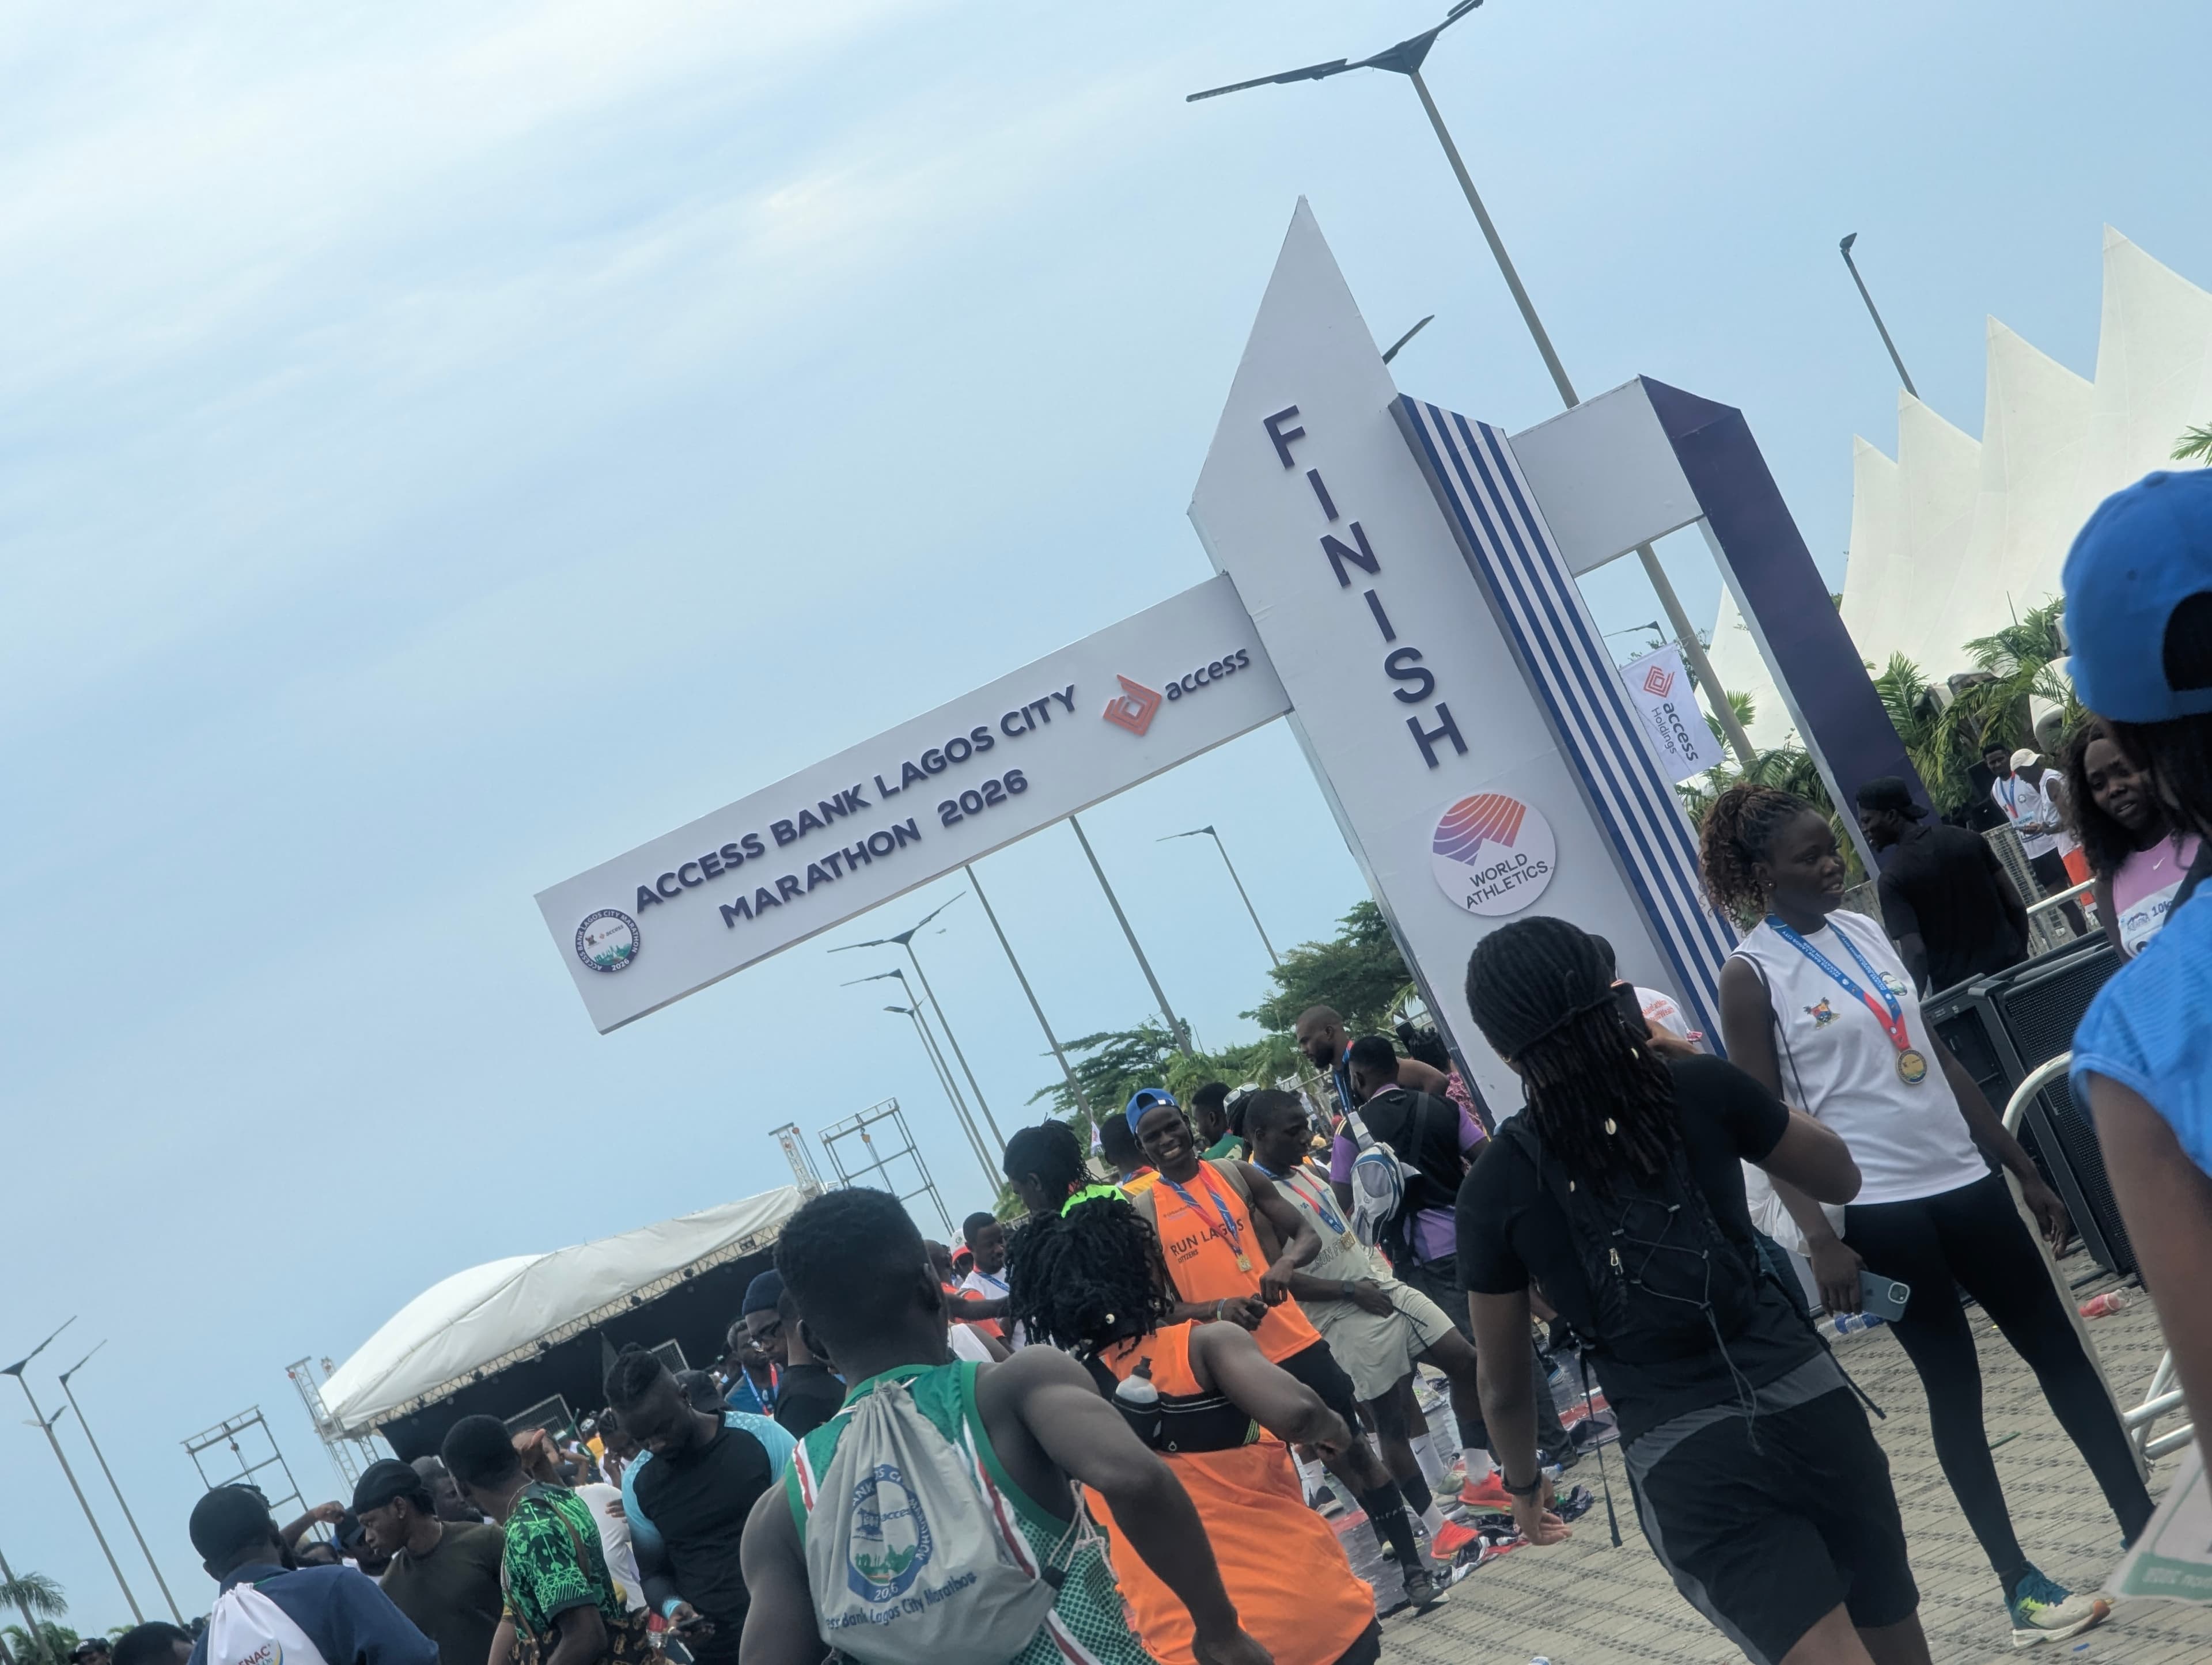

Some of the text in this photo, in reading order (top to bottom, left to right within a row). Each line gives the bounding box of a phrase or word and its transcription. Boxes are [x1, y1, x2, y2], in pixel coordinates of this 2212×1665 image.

[1263, 404, 1469, 770] FINISH
[1165, 648, 1250, 701] access
[1652, 707, 1677, 754] Holdings
[1662, 703, 1699, 762] access
[637, 684, 1076, 914] ACCESS BANK LAGOS CITY
[719, 769, 1028, 929] MARATHON 2026
[1469, 853, 1528, 887] WORLD
[1466, 860, 1548, 909] ATHLETICS
[581, 913, 602, 931] LAGOS
[620, 915, 639, 953] MARATHON
[611, 958, 630, 972] 2026
[1170, 1234, 1198, 1257] RUN
[1200, 1218, 1244, 1242] LAGS
